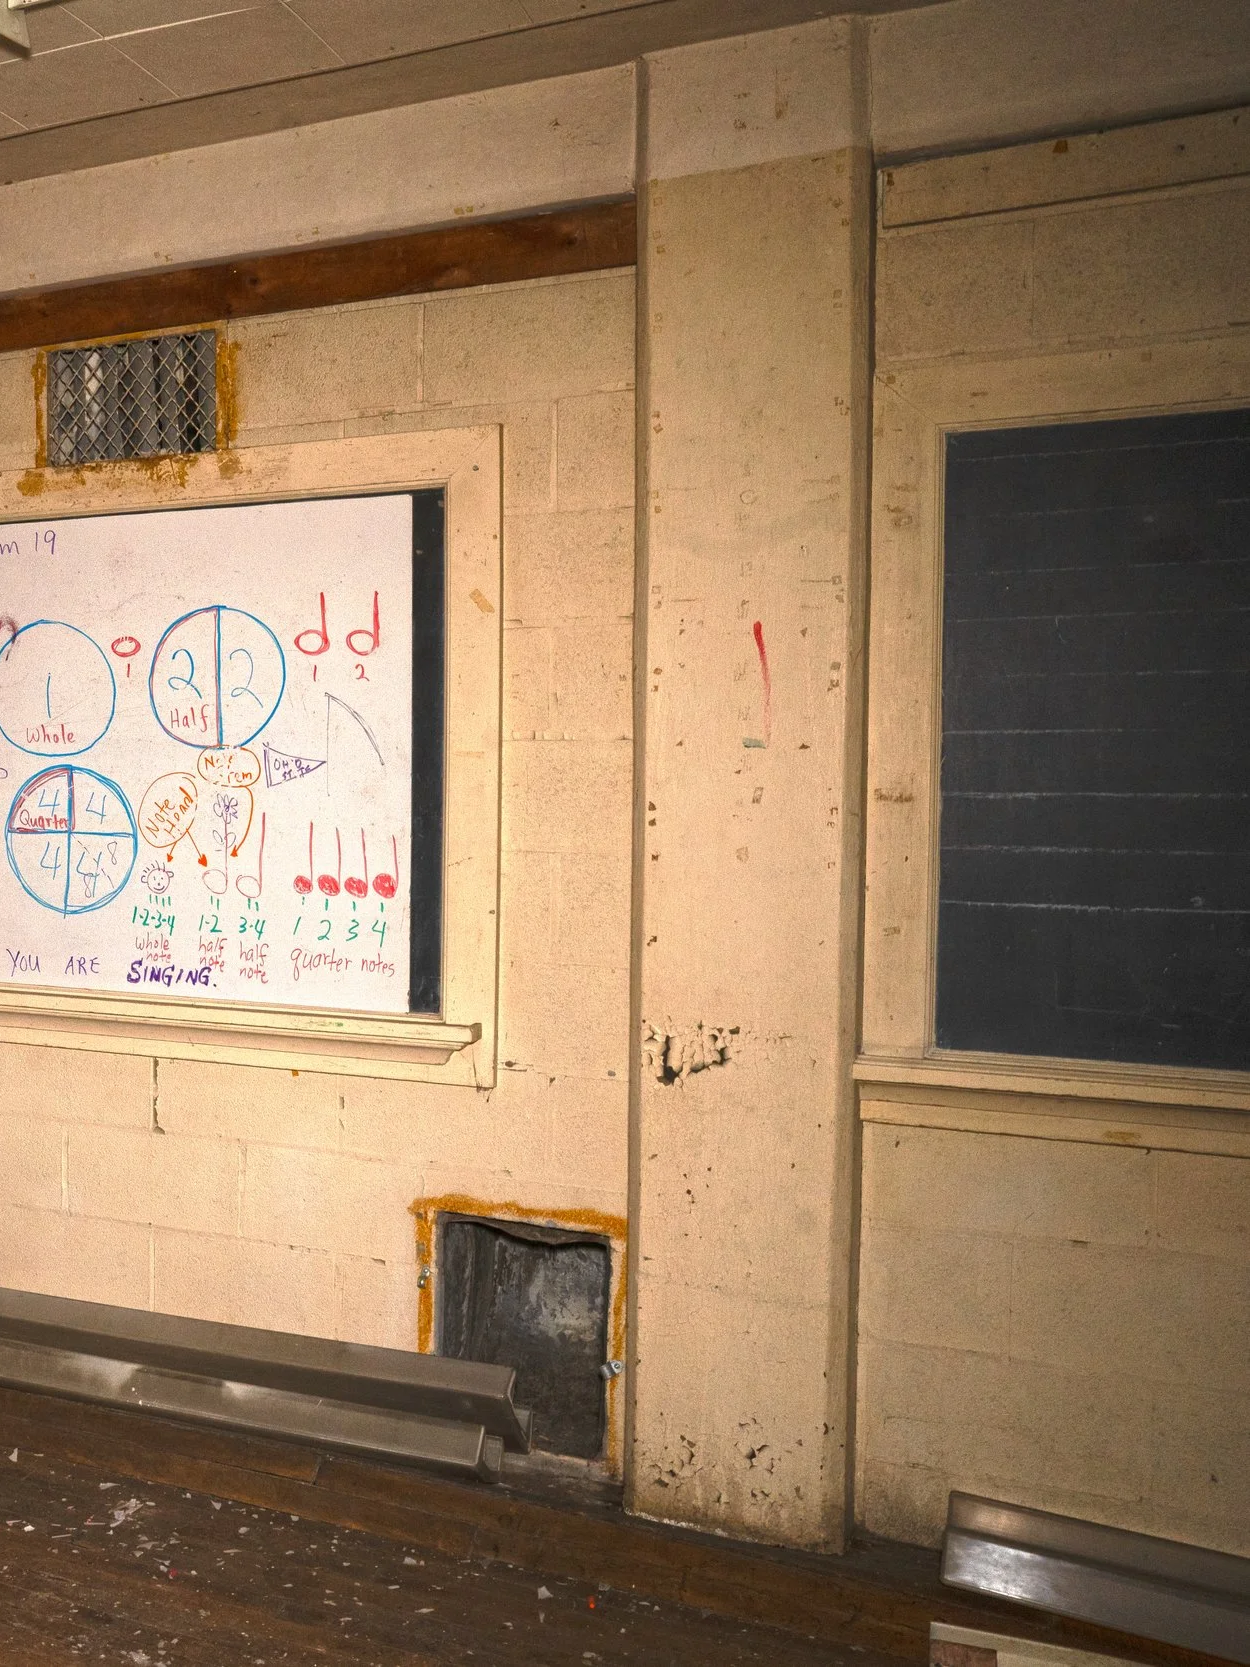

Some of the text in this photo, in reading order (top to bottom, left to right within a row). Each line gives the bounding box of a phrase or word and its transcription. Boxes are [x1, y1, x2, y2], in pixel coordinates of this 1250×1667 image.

[35, 529, 57, 555] 19
[168, 648, 203, 699] 2
[229, 648, 264, 709] 2
[355, 664, 370, 682] 2
[170, 704, 210, 733] Half
[273, 758, 303, 772] OHO
[38, 788, 61, 816] 4
[85, 791, 107, 824] 4
[19, 811, 69, 830] Quarter
[145, 798, 176, 839] Note
[39, 841, 61, 880] 4
[107, 841, 118, 866] 8
[199, 934, 228, 956] half
[293, 916, 387, 948] 1 2 3 4
[146, 950, 172, 964] note
[199, 954, 226, 973] note
[239, 940, 269, 967] half
[290, 948, 395, 979] quarter notes
[6, 948, 40, 973] YOU
[64, 956, 100, 975] ARE
[126, 958, 218, 988] SINGING.
[239, 964, 269, 984] note
